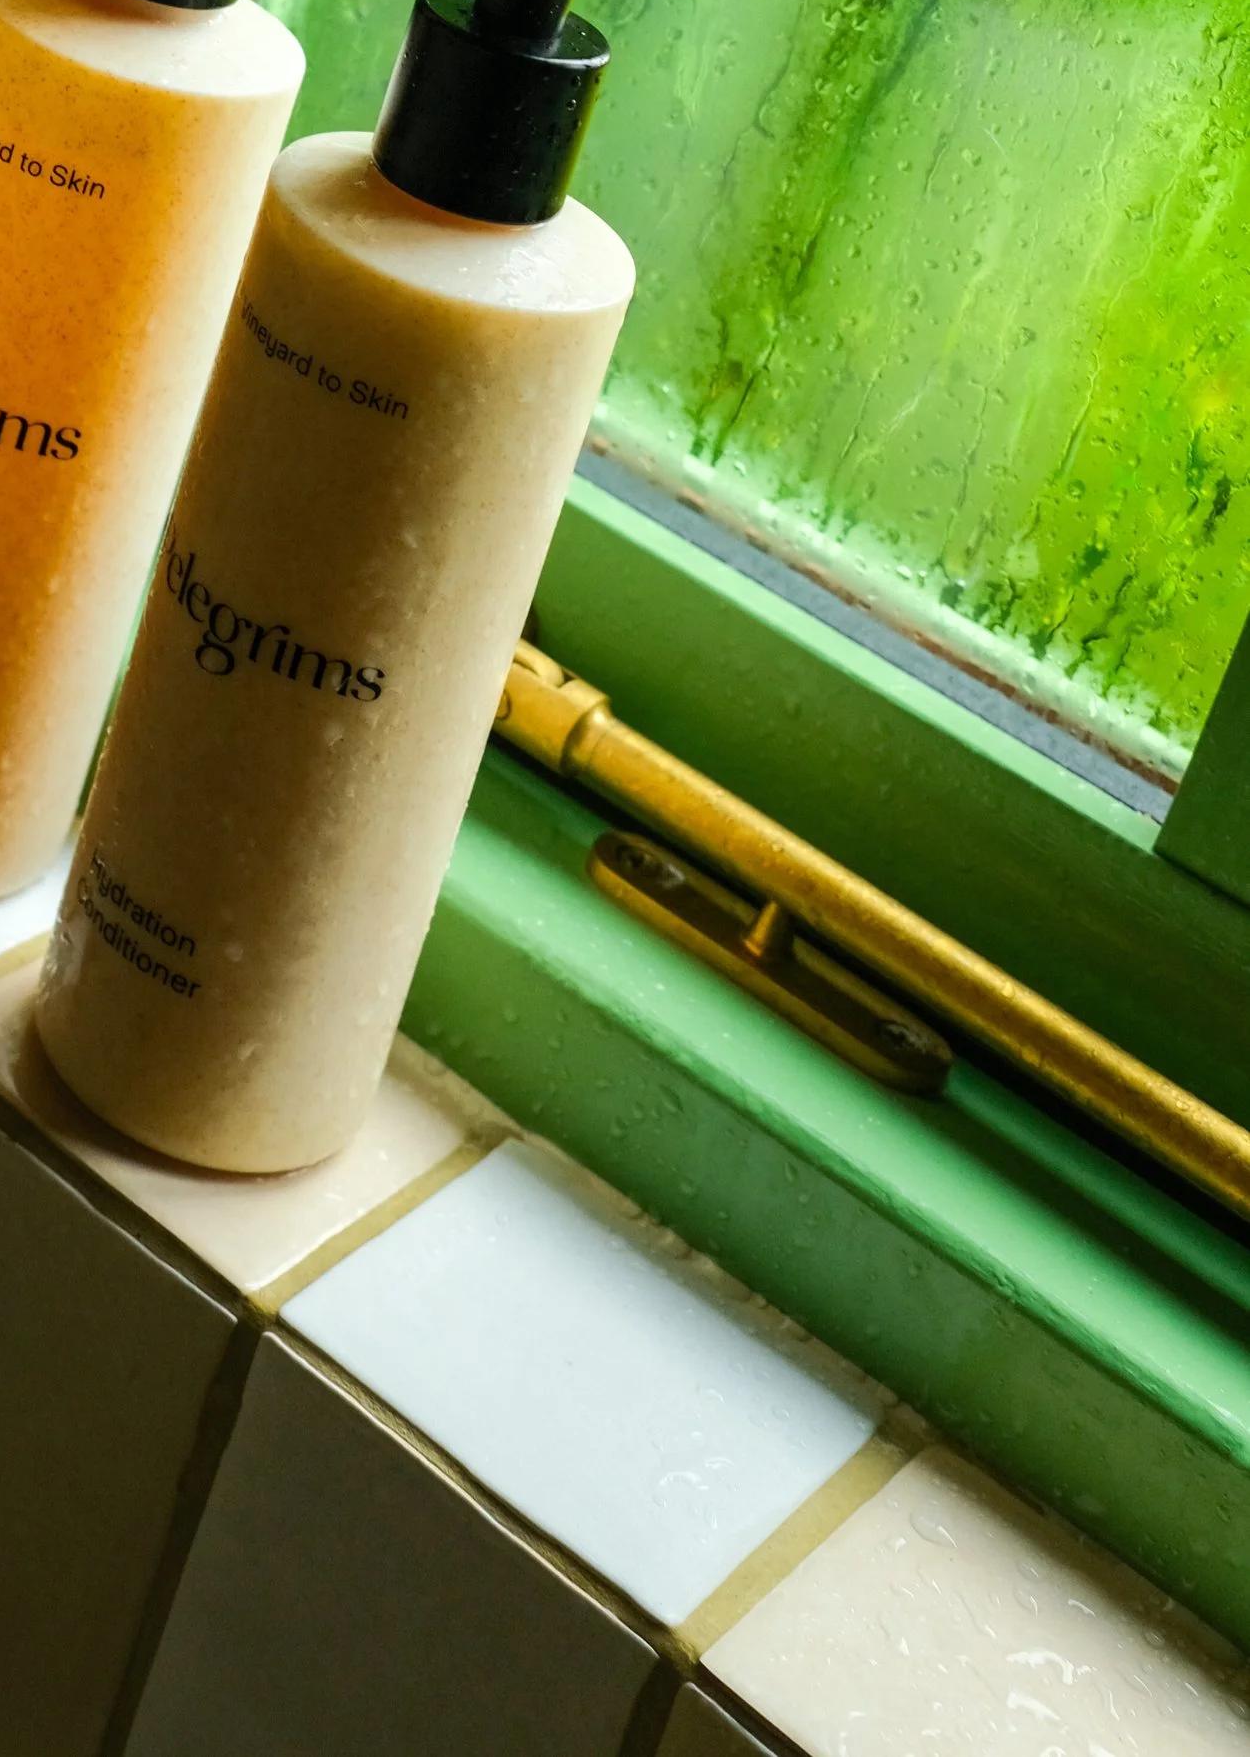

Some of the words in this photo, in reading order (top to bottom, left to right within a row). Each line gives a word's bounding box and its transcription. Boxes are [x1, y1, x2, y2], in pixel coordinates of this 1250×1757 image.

[20, 152, 43, 177] to
[50, 164, 106, 200] Skin
[240, 293, 314, 378] Vineyard
[317, 364, 342, 393] to
[349, 379, 409, 420] Skin
[166, 523, 386, 702] elegrims
[77, 877, 202, 999] Conditioner
